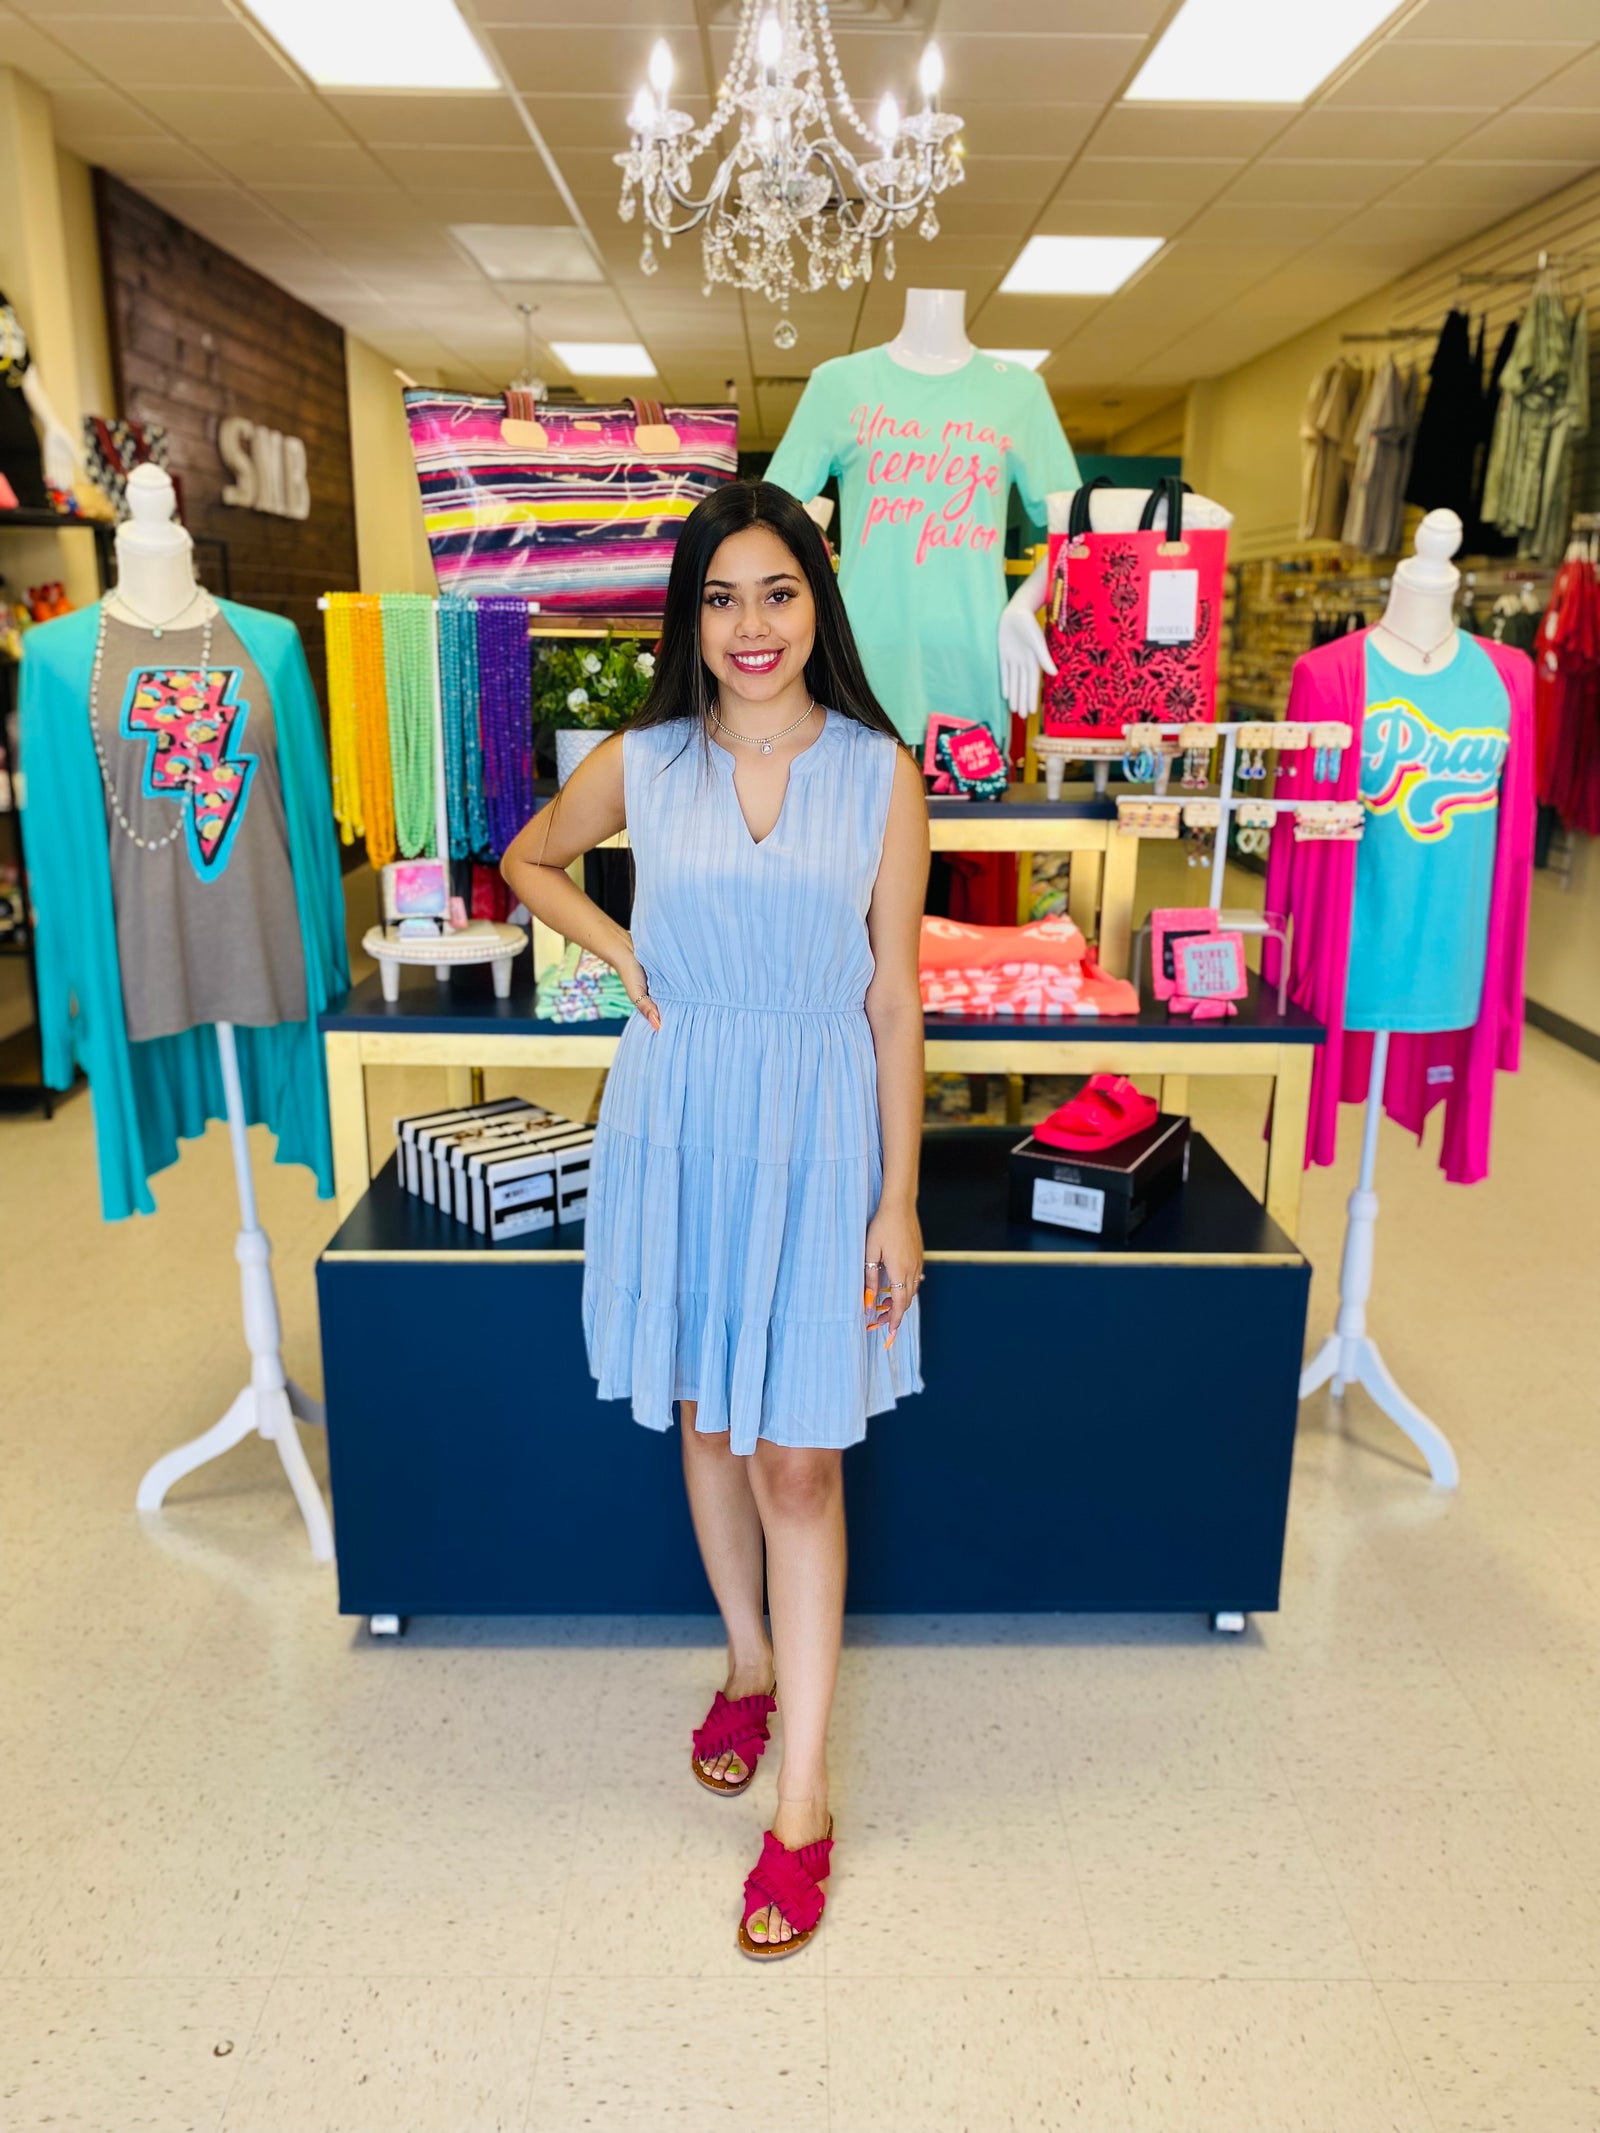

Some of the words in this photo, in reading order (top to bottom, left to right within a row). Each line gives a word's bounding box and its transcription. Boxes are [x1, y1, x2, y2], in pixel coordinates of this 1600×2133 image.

[850, 403, 931, 450] Una
[867, 443, 1001, 522] cerveza
[860, 496, 924, 547] por
[914, 512, 999, 566] favor
